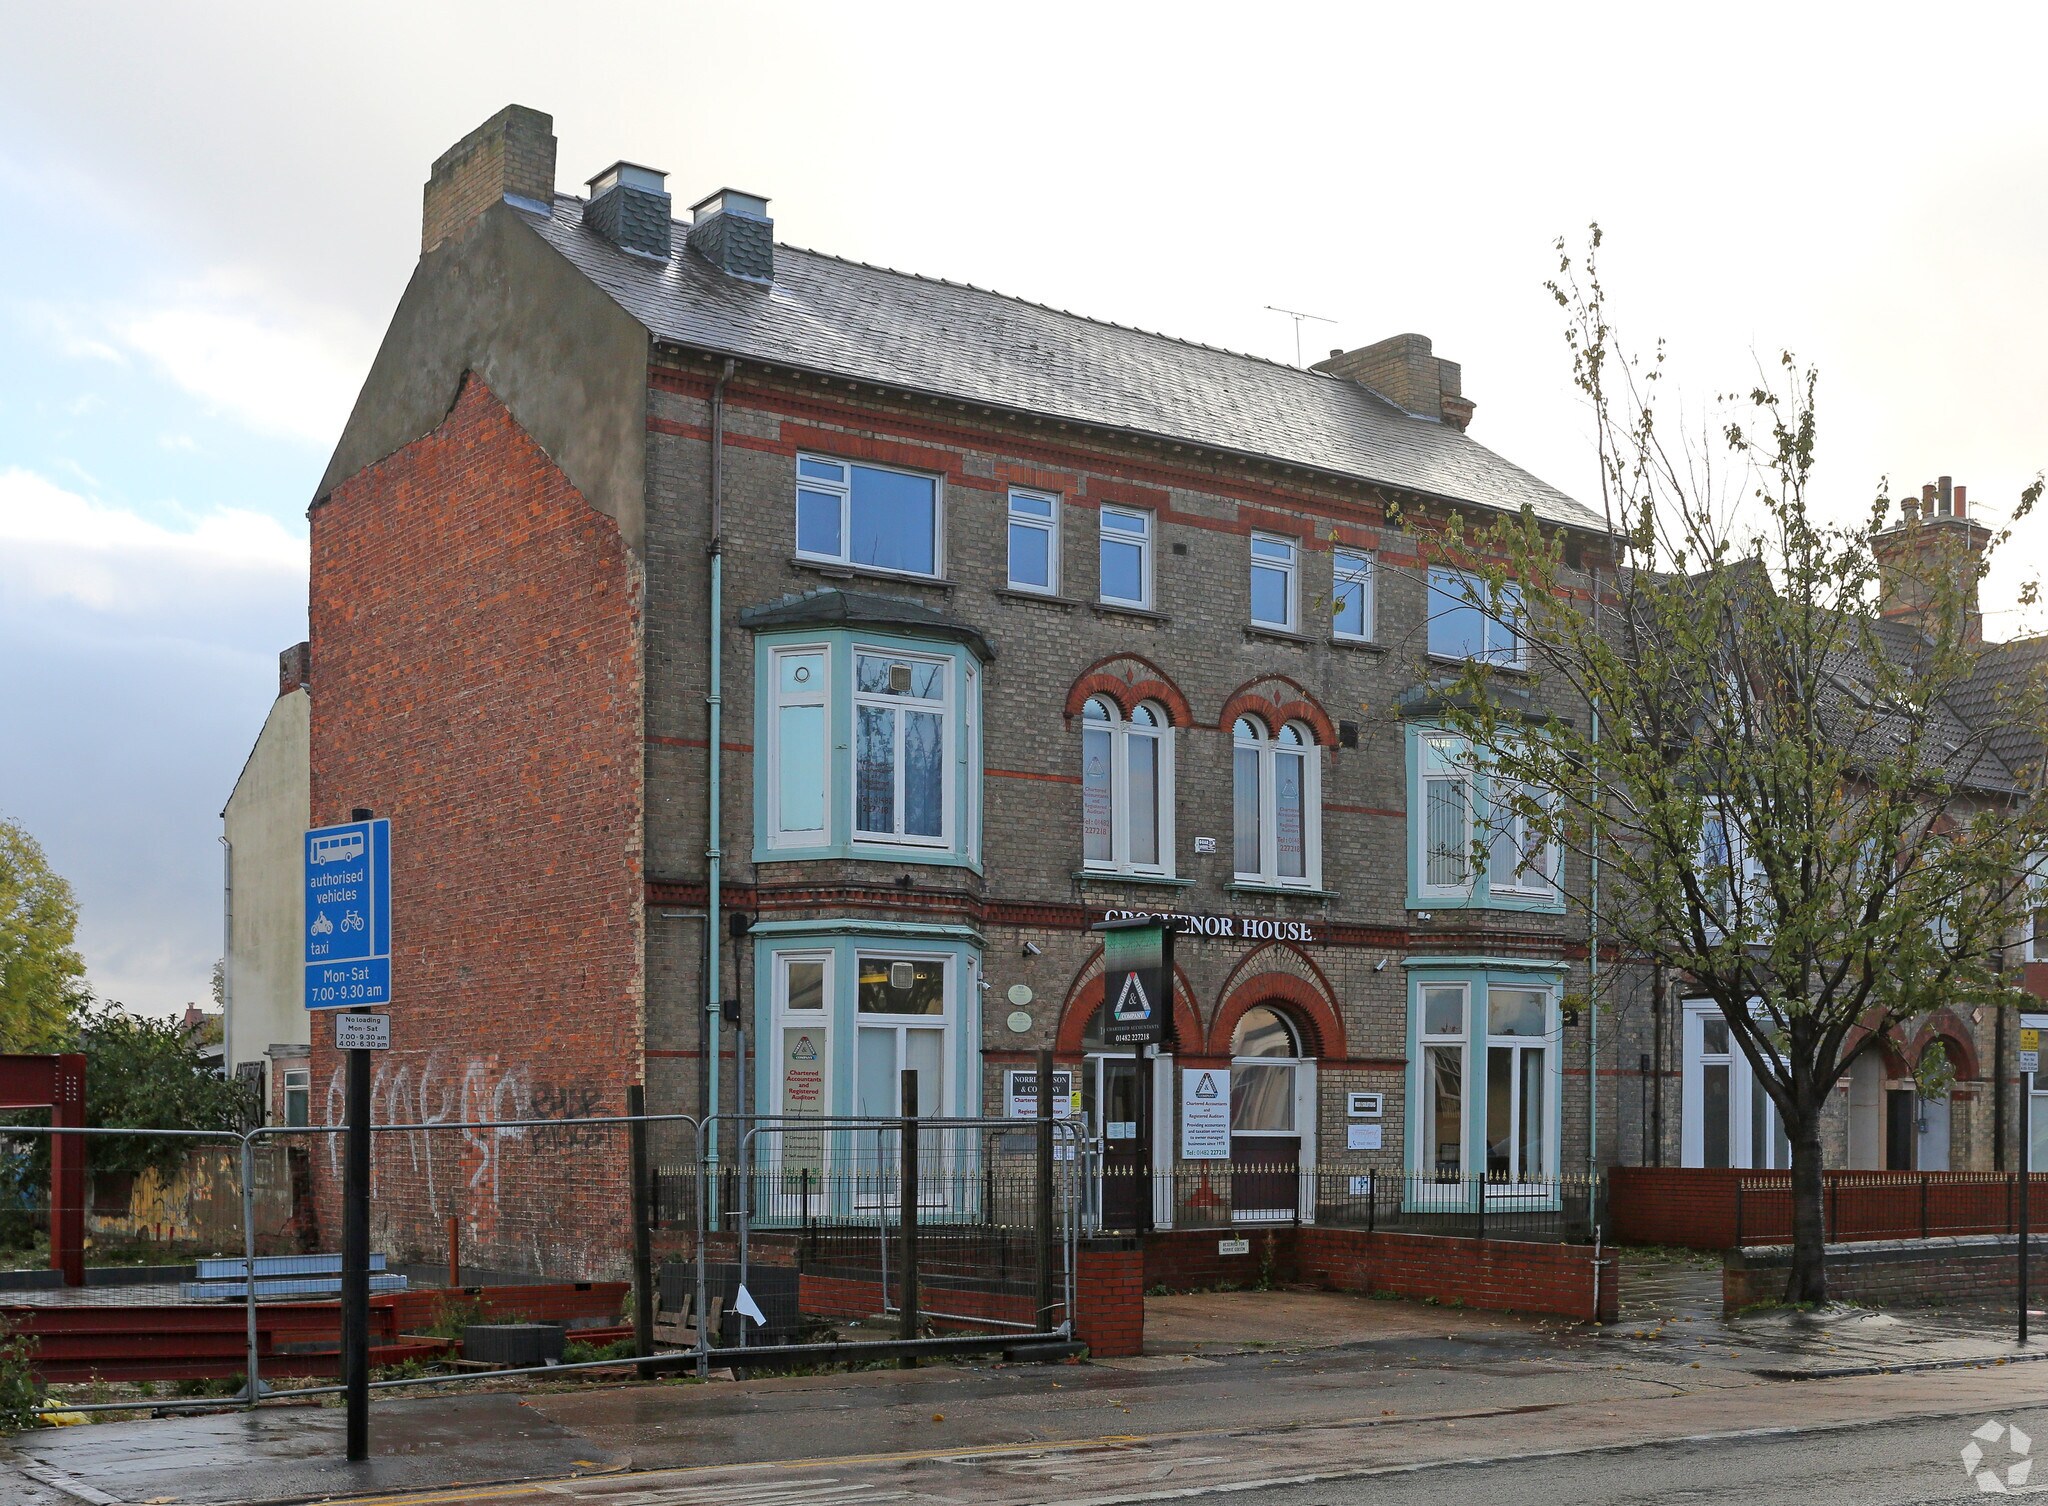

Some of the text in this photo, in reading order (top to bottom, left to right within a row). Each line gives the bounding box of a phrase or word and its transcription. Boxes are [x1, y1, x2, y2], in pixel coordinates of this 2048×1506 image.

[1085, 826, 1107, 836] 227218
[310, 868, 364, 888] authorised
[317, 888, 357, 904] vehicles
[311, 941, 329, 955] taxi
[366, 985, 382, 997] am
[1128, 992, 1138, 1005] &
[356, 1016, 381, 1024] loading
[1115, 1032, 1150, 1042] 01482 227218
[1014, 1076, 1037, 1084] NORRI
